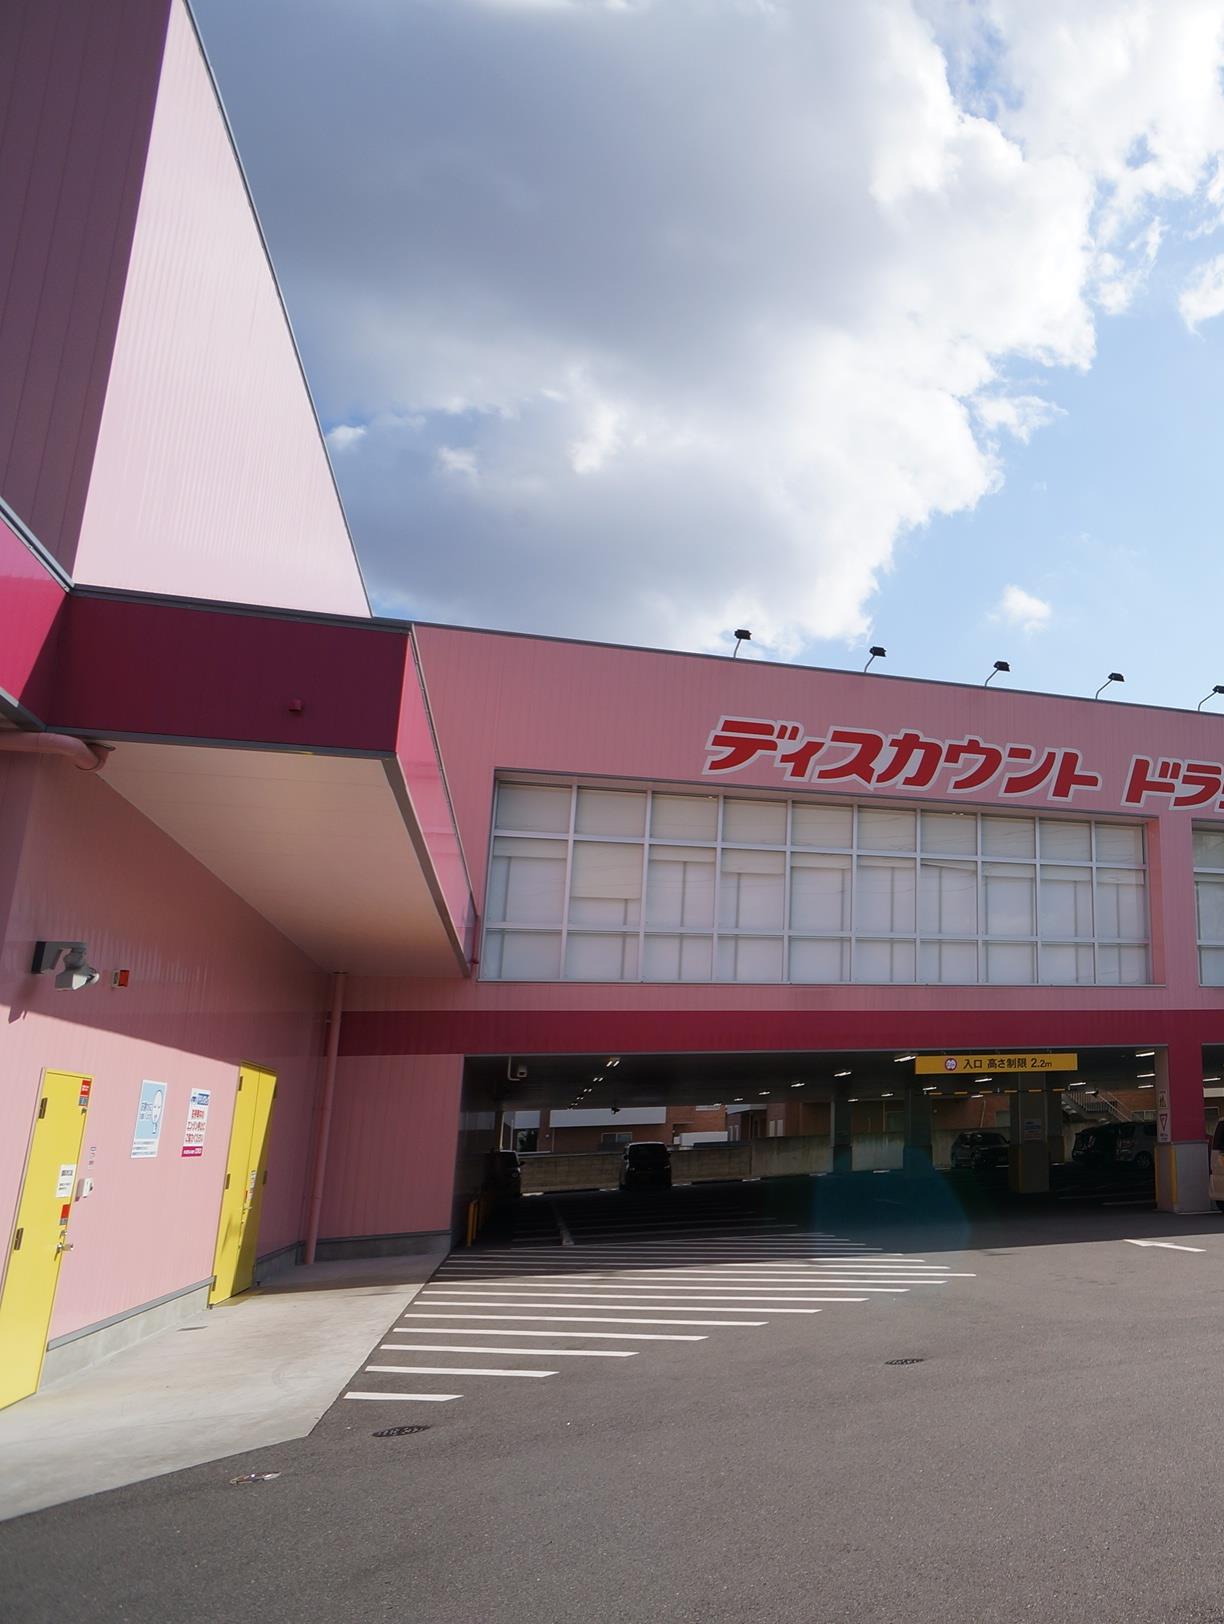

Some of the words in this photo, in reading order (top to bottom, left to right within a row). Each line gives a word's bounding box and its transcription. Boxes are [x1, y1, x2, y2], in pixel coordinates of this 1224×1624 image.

[703, 715, 1101, 801] ディスカウント
[963, 1059, 983, 1070] 入口
[987, 1058, 1027, 1069] 高さ制限
[1030, 1057, 1053, 1069] 2.2m
